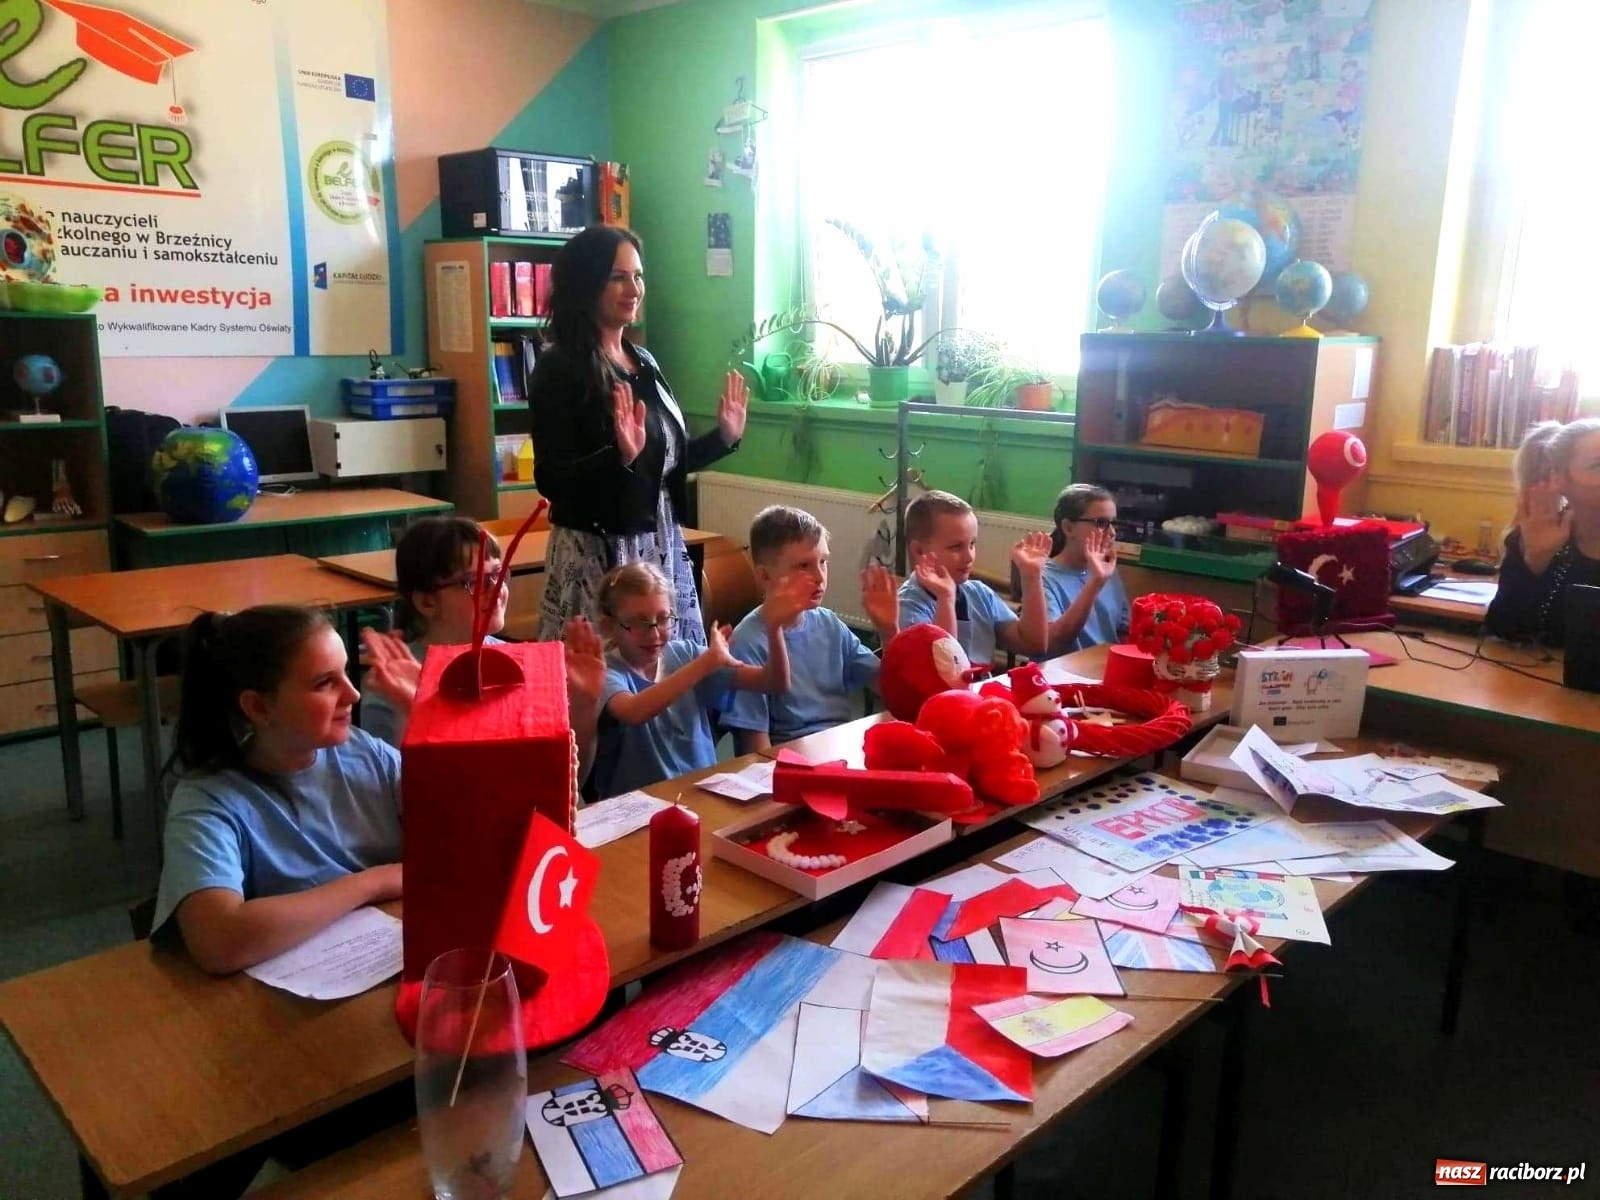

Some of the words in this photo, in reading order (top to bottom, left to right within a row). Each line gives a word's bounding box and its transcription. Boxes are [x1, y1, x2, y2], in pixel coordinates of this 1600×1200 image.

[61, 211, 159, 229] nauczycieli
[136, 232, 150, 244] w
[156, 231, 232, 251] Brzeźnicy
[144, 246, 148, 260] i
[153, 248, 278, 266] samokształceniu
[130, 283, 272, 310] inwestycja
[107, 321, 188, 333] Wykwalifikowane
[190, 321, 217, 333] Kadry
[219, 323, 257, 334] Systemu
[259, 323, 292, 335] Oświaty
